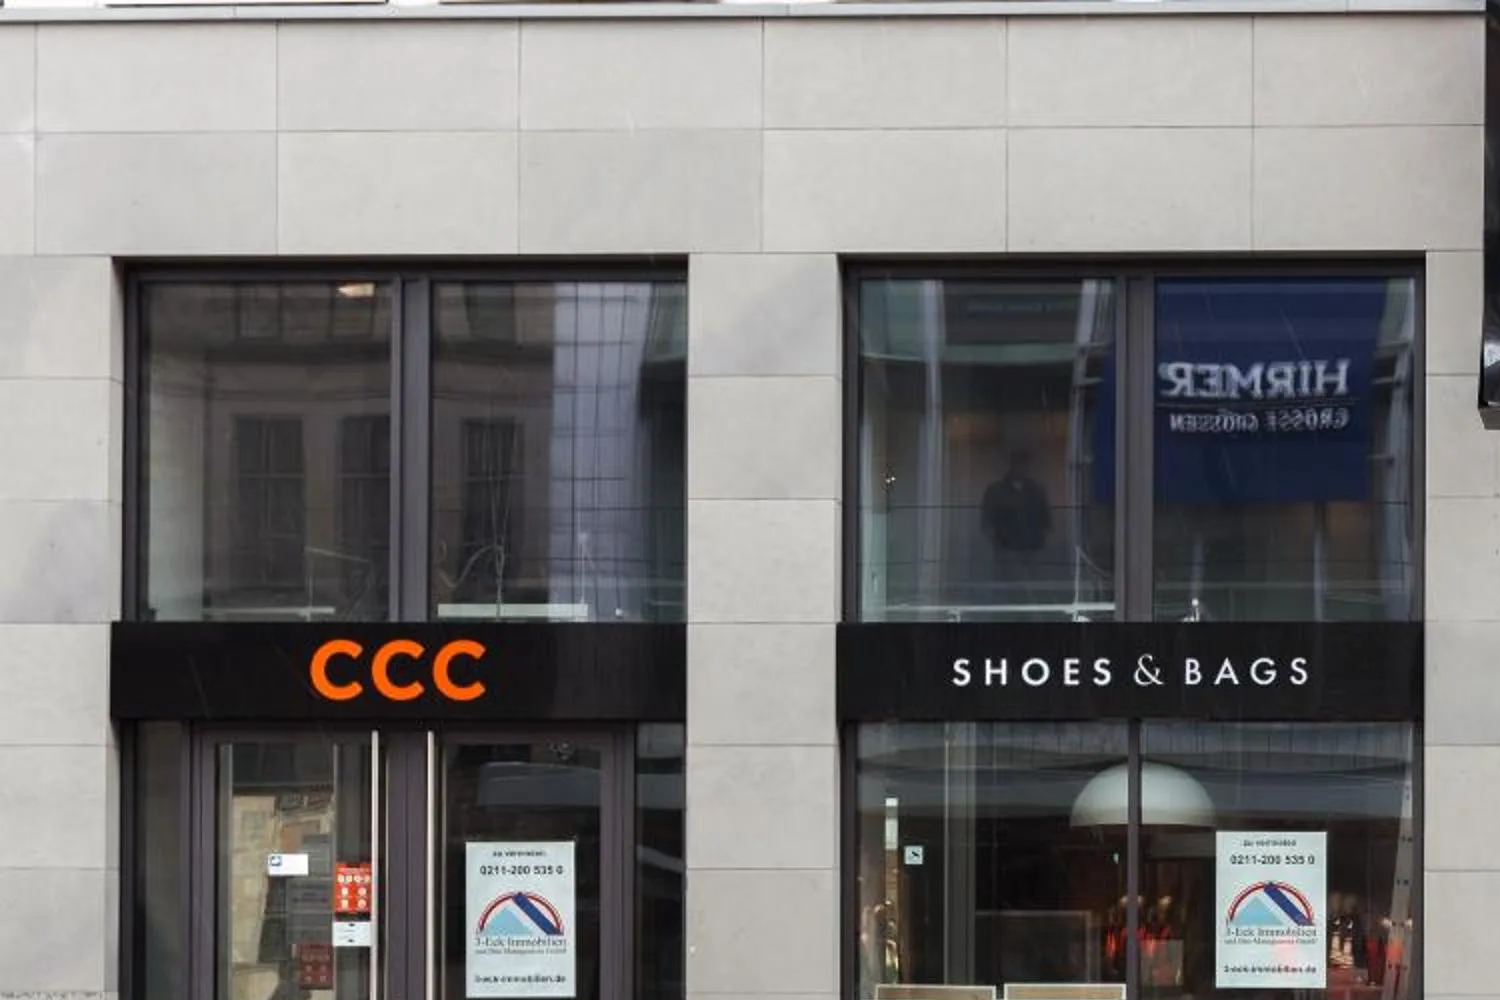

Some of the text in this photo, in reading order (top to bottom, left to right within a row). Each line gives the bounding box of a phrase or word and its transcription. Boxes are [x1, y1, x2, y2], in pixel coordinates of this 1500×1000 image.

[310, 639, 486, 701] CCC
[952, 654, 1310, 687] SHOES & BAGS
[480, 865, 564, 876] 0211-200 535 0
[1230, 854, 1315, 865] 0211-200 535 0
